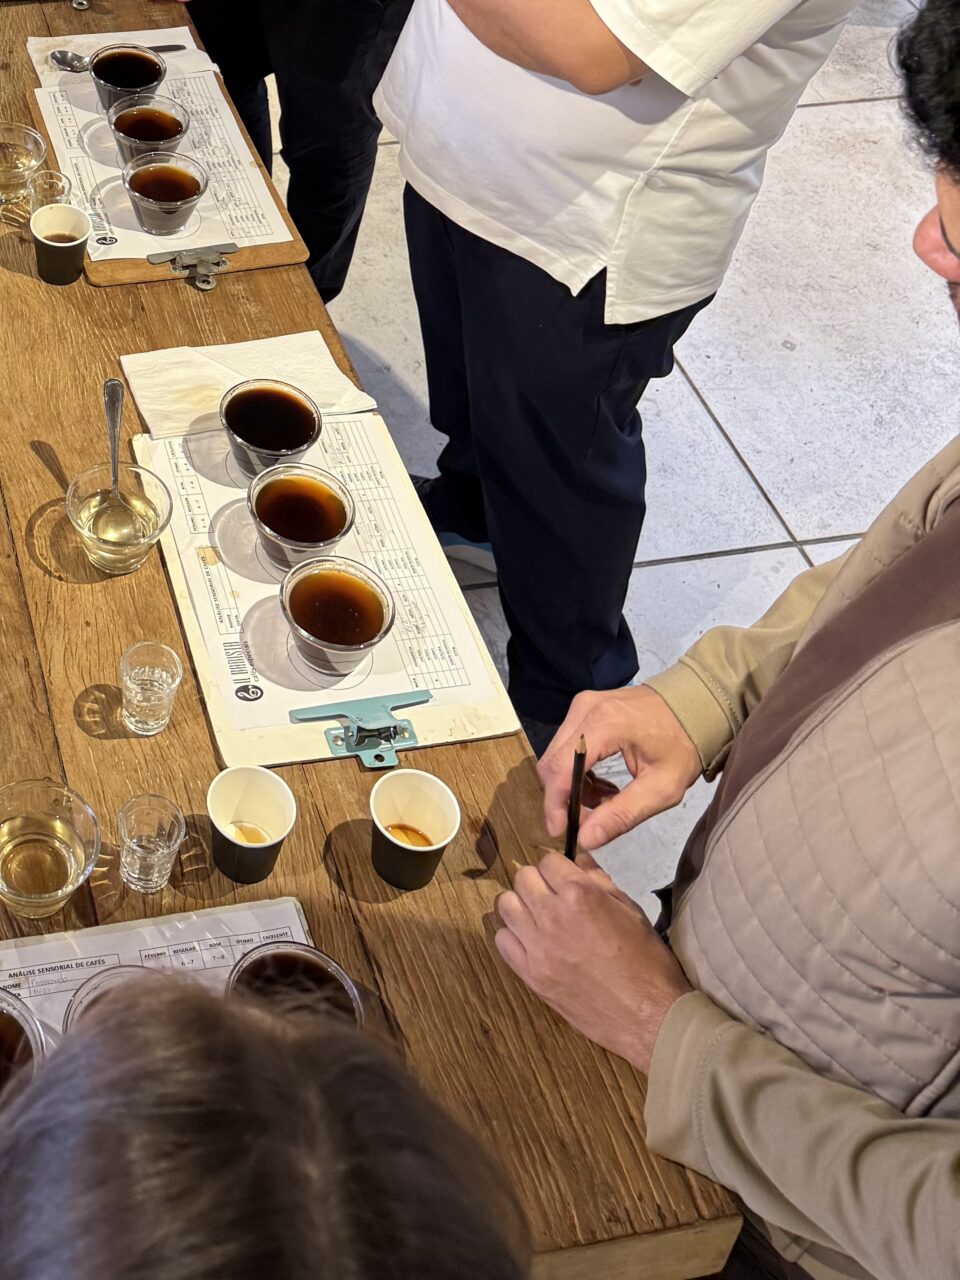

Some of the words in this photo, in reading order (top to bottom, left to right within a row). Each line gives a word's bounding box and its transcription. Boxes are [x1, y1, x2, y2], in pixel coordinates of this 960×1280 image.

[208, 577, 219, 602] SENSORIAL
[223, 641, 249, 675] BARISTA
[8, 969, 36, 979] ANÁLISE
[37, 963, 74, 974] SENSORIAL
[76, 961, 85, 969] DE
[85, 957, 106, 967] CAFÉS
